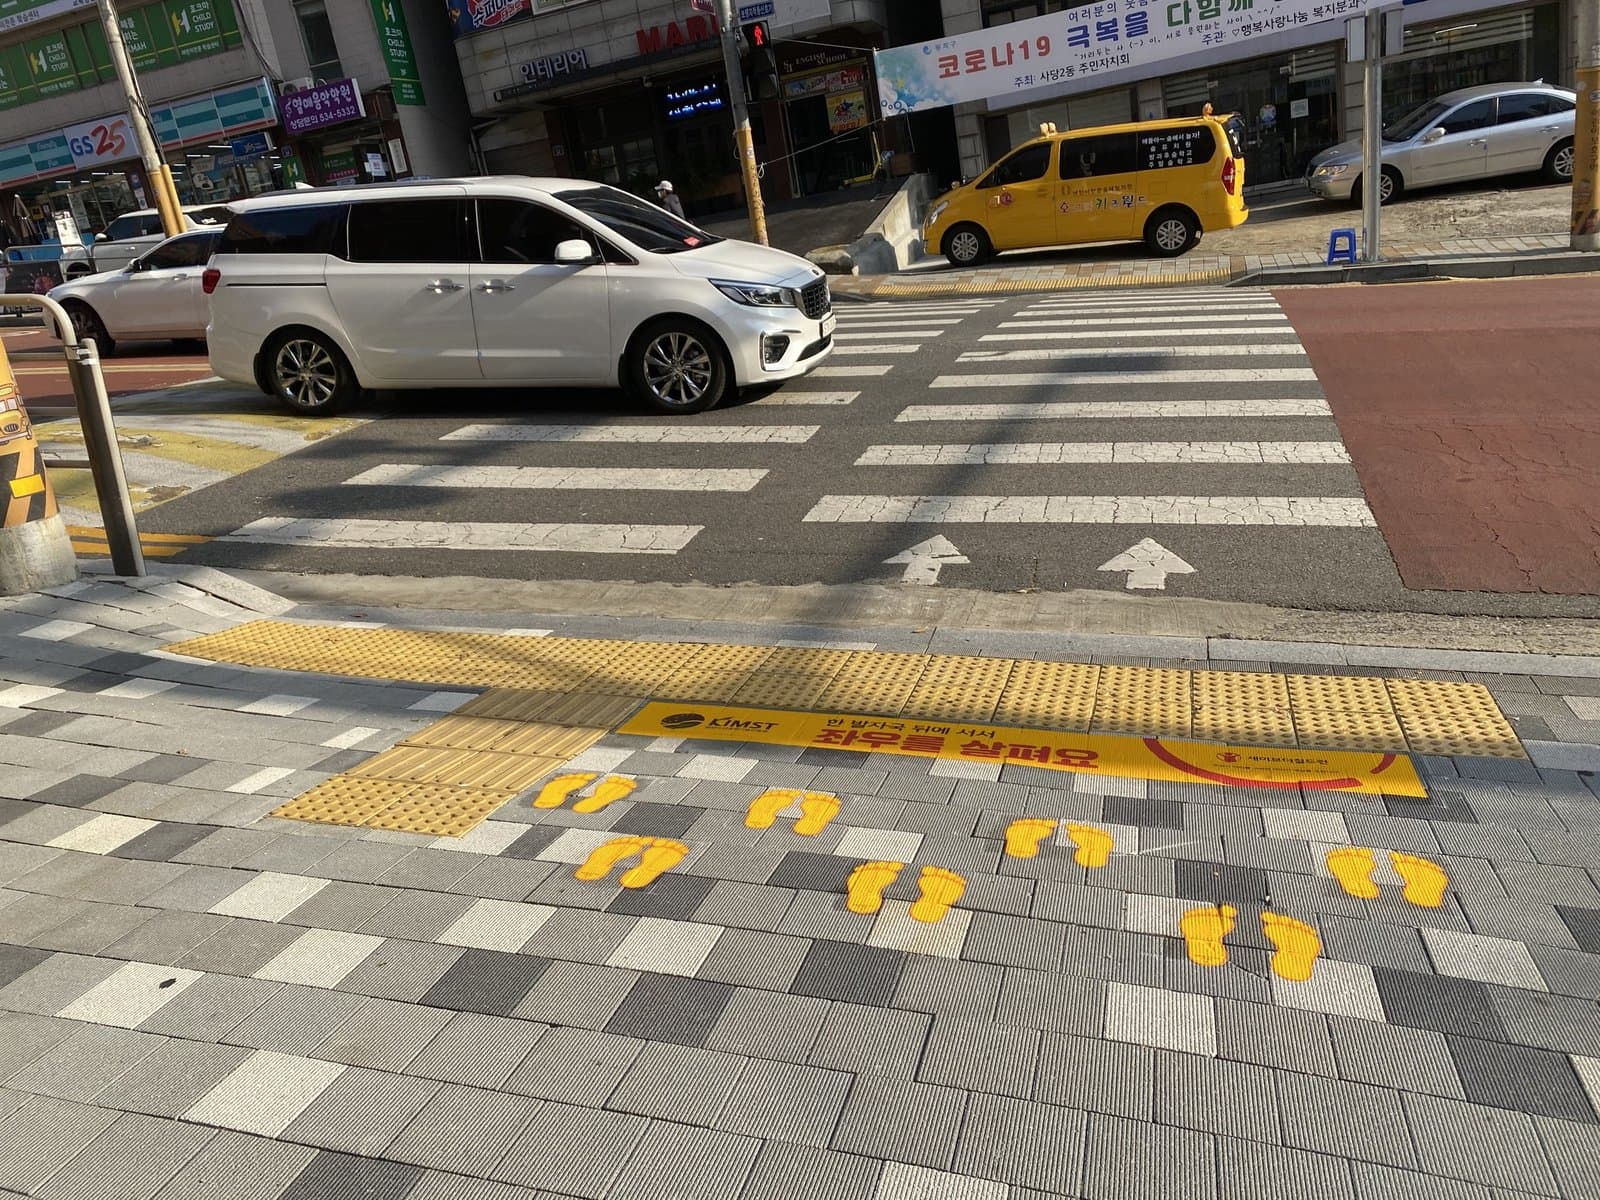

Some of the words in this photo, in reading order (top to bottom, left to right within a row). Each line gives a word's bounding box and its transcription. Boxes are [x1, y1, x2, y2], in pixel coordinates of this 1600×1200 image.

[1068, 1, 1117, 22] 여러분의
[194, 21, 215, 33] STUDY
[1241, 12, 1309, 37] 행복사랑나눔
[938, 35, 1051, 79] 코로나19
[1067, 10, 1149, 48] 극복을
[520, 48, 589, 84] 인테리어
[1040, 65, 1075, 82] 사당2동
[1078, 53, 1130, 74] 주민자치회
[290, 115, 318, 130] 상담문의
[319, 105, 356, 123] 534-5332
[69, 119, 126, 156] GS25
[708, 717, 779, 730] KIMST
[827, 718, 844, 728] 한
[850, 719, 904, 733] 발자국
[912, 724, 950, 736] 뒤에
[958, 726, 995, 739] 서서
[812, 728, 945, 754] 좌우를
[959, 739, 1100, 770] 살펴요
